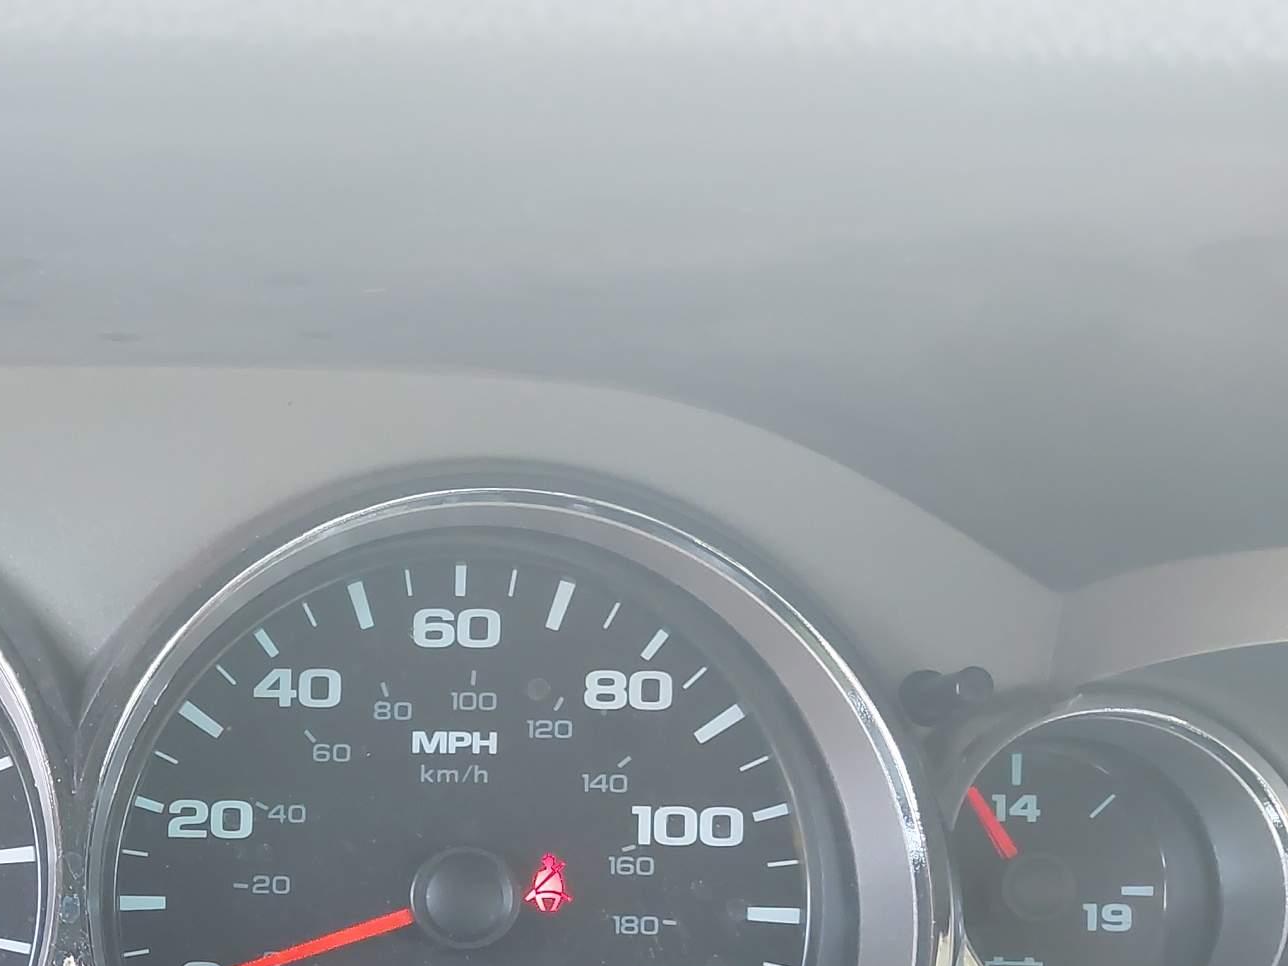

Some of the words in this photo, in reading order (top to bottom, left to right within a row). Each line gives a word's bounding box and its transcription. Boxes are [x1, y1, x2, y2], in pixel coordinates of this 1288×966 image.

[412, 608, 501, 648] 60
[253, 668, 342, 708] 40
[584, 670, 673, 710] 80
[373, 701, 412, 720] 80
[451, 692, 497, 711] 100
[527, 719, 573, 739] 120
[411, 731, 498, 754] MPH
[312, 744, 351, 762] 60
[420, 764, 489, 783] km/h
[582, 773, 628, 793] 140
[268, 804, 307, 824] 40
[992, 794, 1041, 822] 14
[168, 800, 253, 838] 20
[631, 805, 744, 847] 100
[608, 856, 655, 876] 160
[252, 875, 291, 895] 20
[612, 915, 659, 935] 180
[1082, 903, 1132, 932] 19
